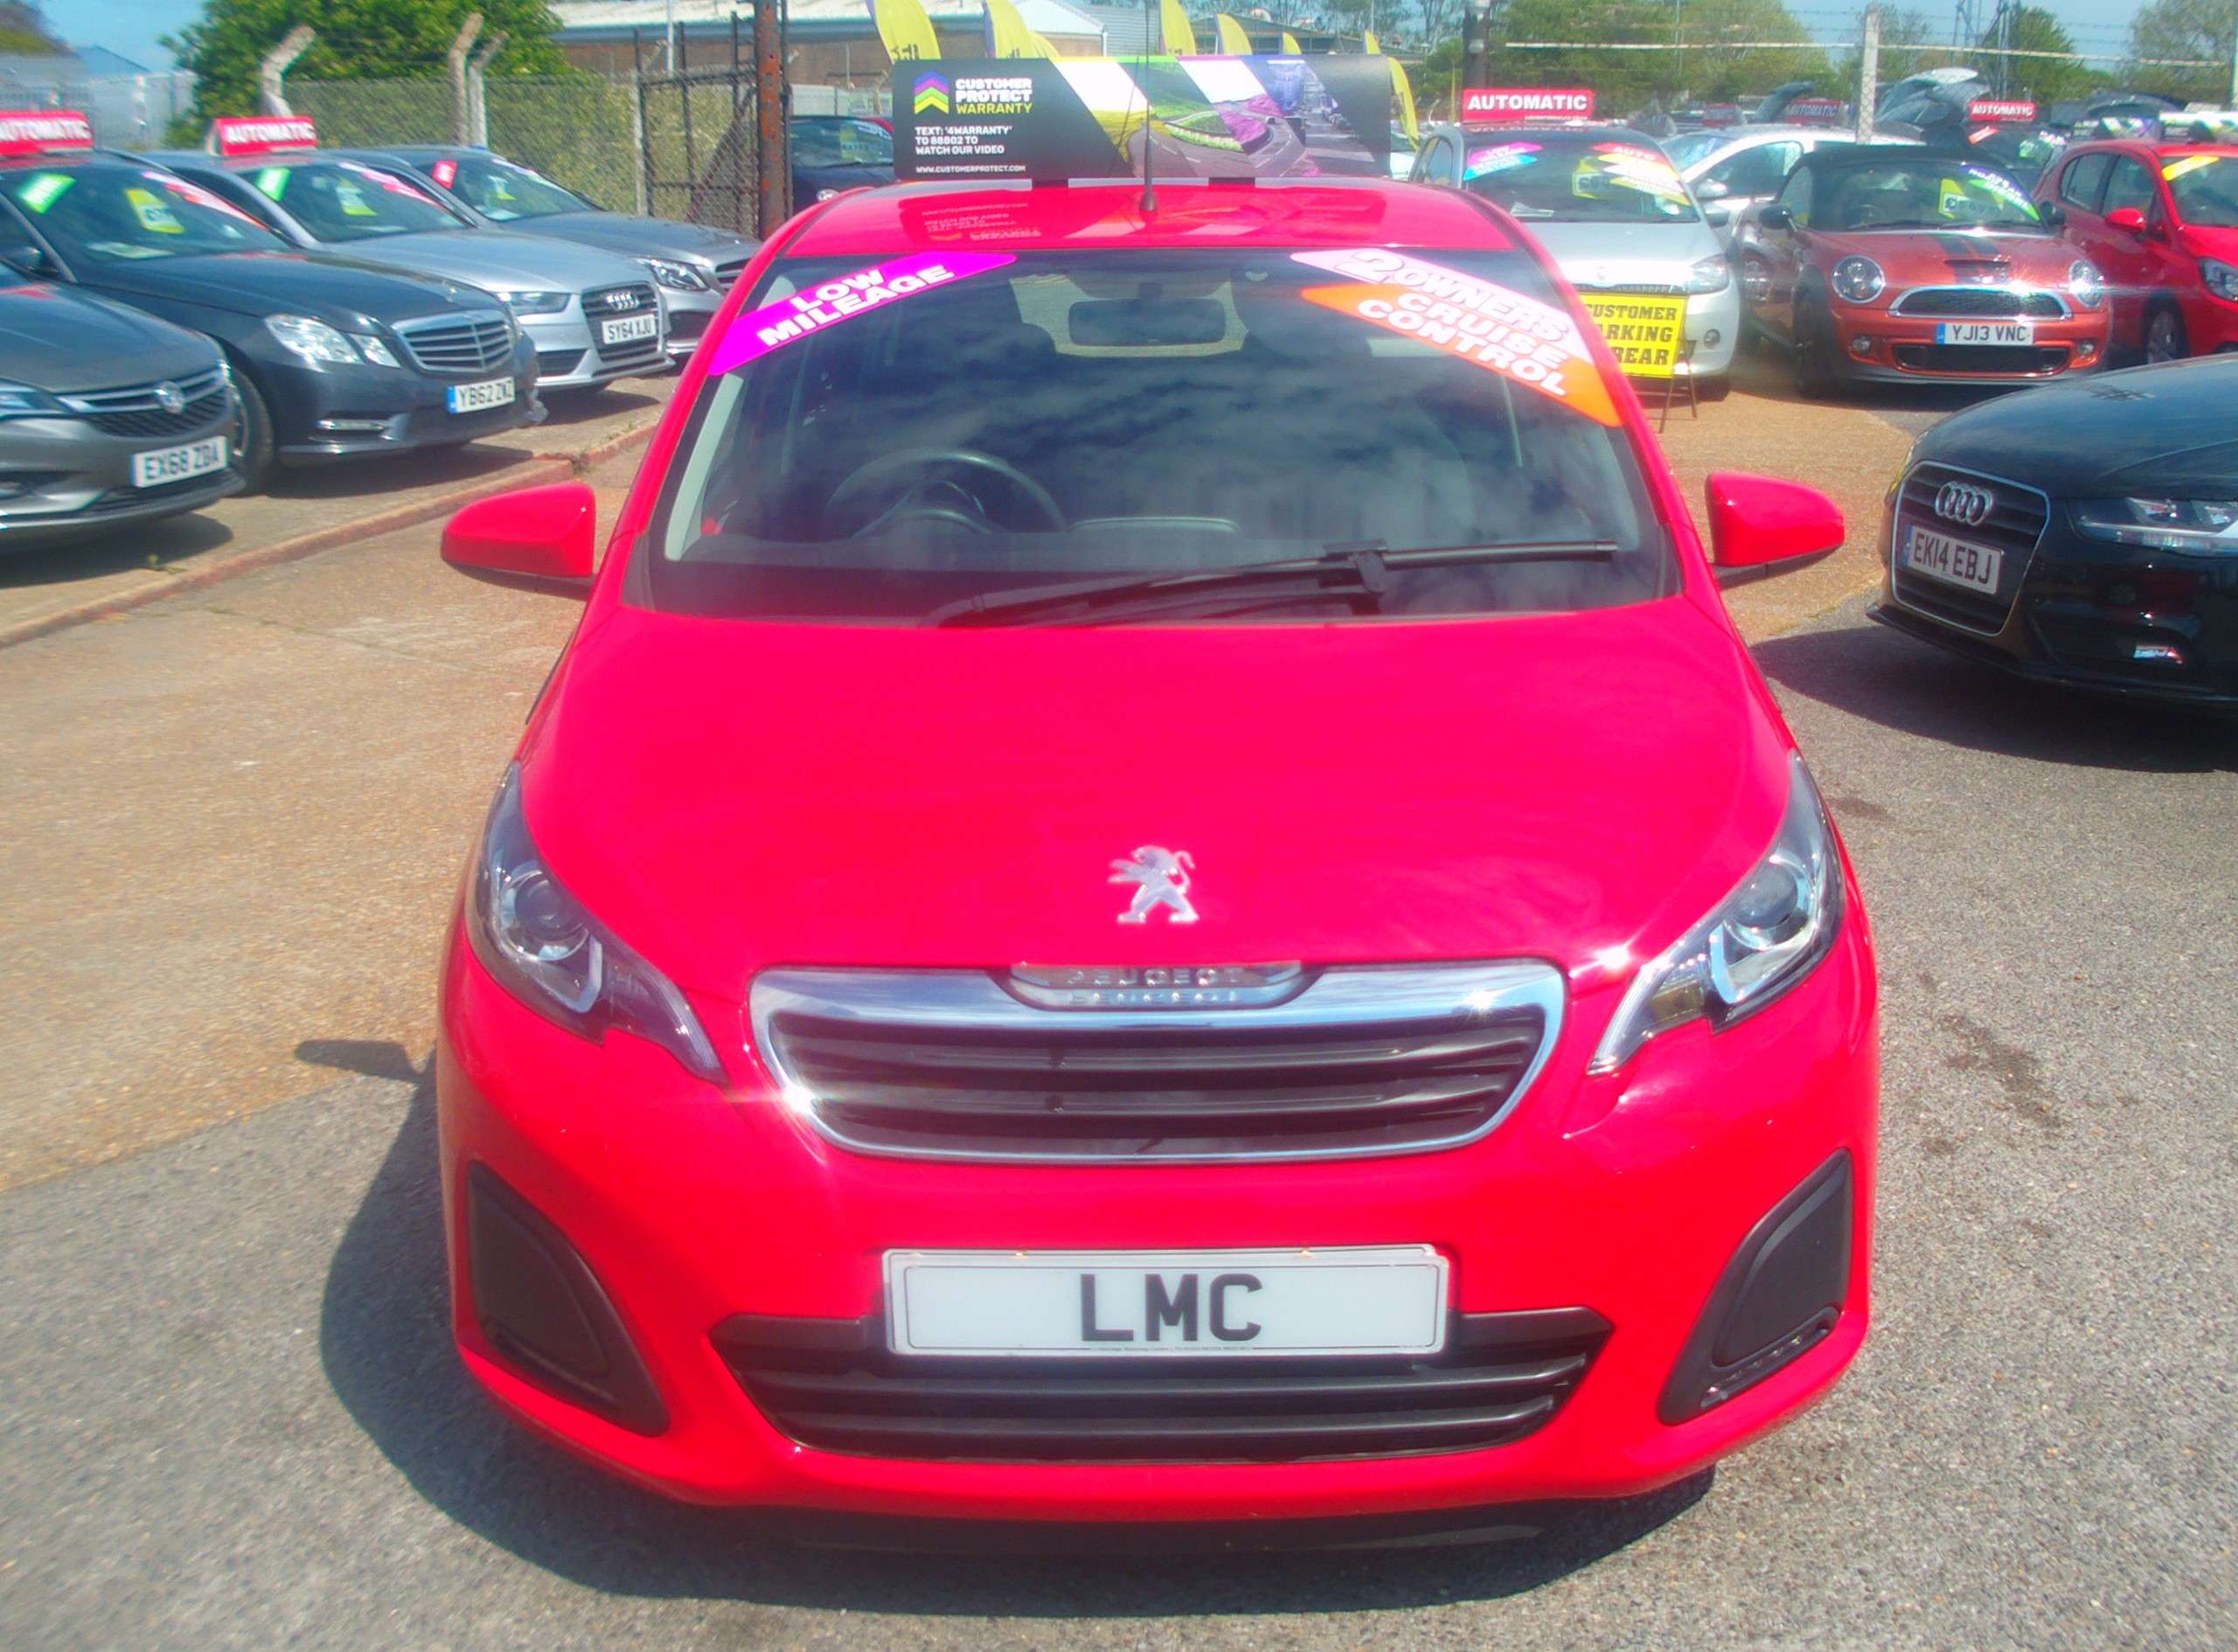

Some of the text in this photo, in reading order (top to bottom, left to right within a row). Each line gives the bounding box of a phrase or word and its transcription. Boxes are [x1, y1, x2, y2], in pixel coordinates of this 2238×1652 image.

[955, 78, 1032, 89] CUSTOMER
[955, 90, 1032, 102] PROTECT
[1468, 94, 1588, 111] AUTOMATIC
[956, 103, 1032, 114] WARRANTY
[1971, 105, 2033, 115] AUTOMATIC
[224, 121, 316, 143] AUTOMATIC
[914, 127, 943, 135] TEXT:
[915, 136, 929, 145] TO
[965, 135, 978, 144] TO
[915, 145, 1004, 155] WATCH OUR VIDEO
[915, 164, 1026, 174] WWW.CUSTOMERPROTECT.COM
[790, 269, 886, 312] LOW
[1336, 250, 1570, 342] 2 OWNERS
[757, 265, 956, 347] MILEAGE
[1399, 293, 1567, 369] CRUISE
[1952, 325, 2027, 342] YJ13 VNC
[1359, 300, 1567, 396] CONTROL
[144, 448, 190, 480] EX68
[1913, 532, 1992, 585] EK14 EBJ
[1081, 1273, 1264, 1343] LMC
